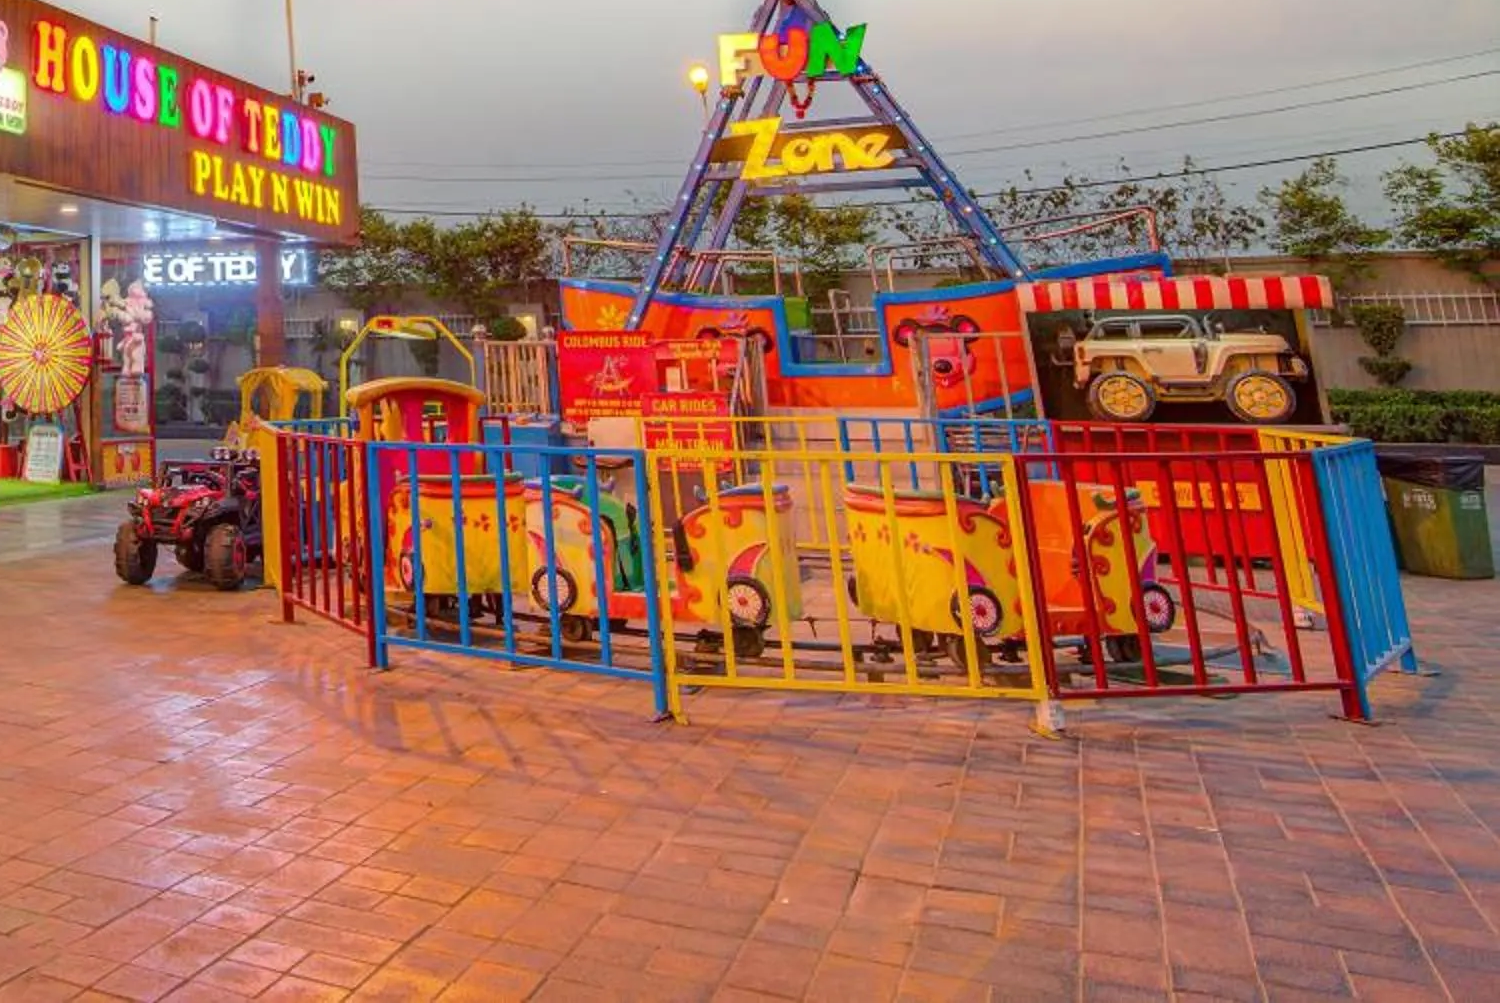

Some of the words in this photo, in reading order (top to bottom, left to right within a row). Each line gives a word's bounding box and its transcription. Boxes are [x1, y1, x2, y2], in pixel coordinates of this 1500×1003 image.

[717, 21, 868, 86] FUN
[36, 20, 181, 127] HOUSE
[190, 78, 234, 145] OF
[243, 98, 337, 178] TEDDY
[192, 149, 266, 209] PLAY
[270, 172, 290, 214] N
[293, 177, 341, 226] WIN
[168, 256, 203, 282] OF
[651, 398, 677, 412] CAR
[679, 399, 717, 413] RIDES
